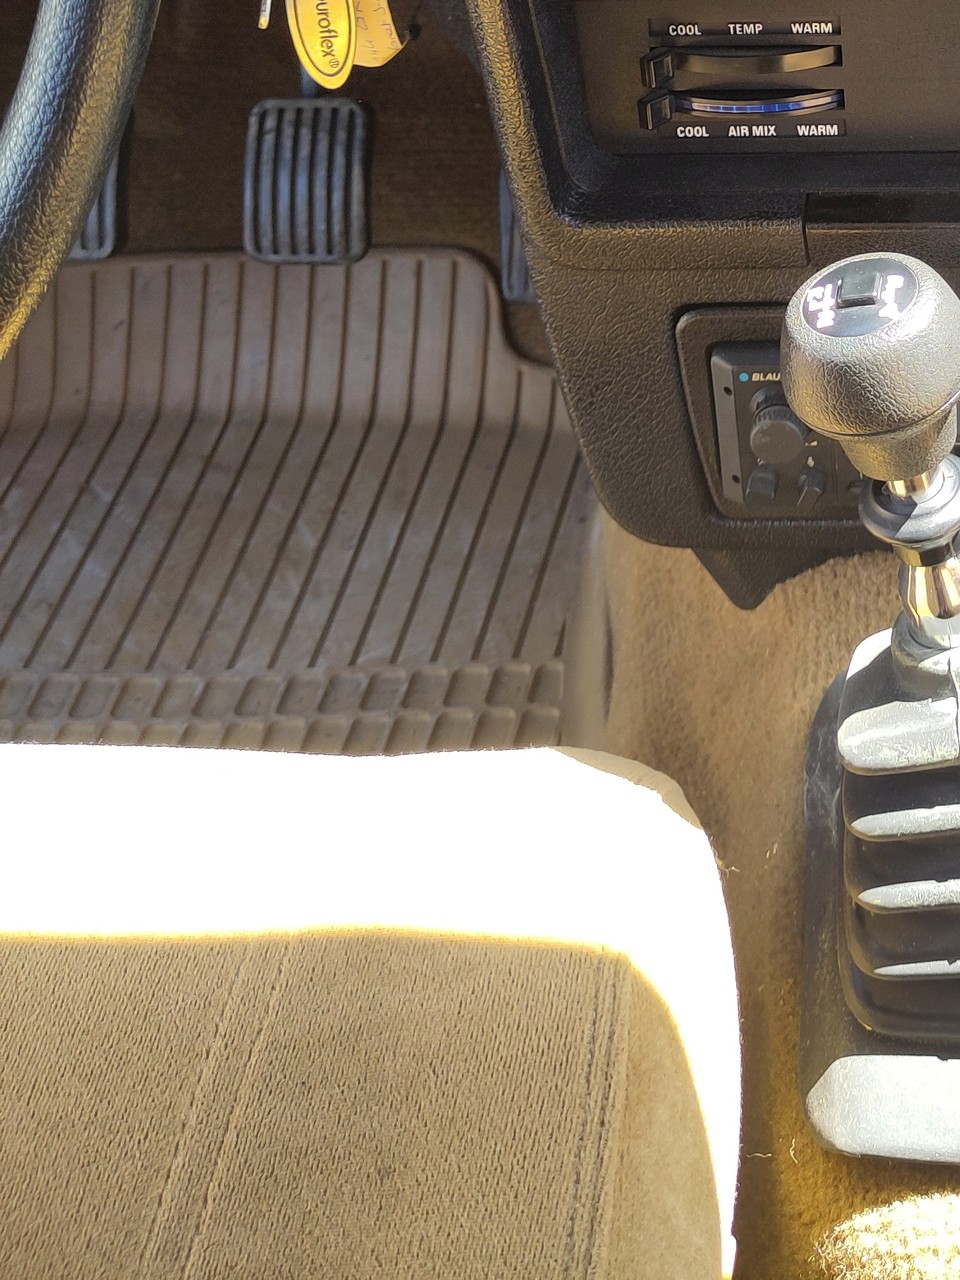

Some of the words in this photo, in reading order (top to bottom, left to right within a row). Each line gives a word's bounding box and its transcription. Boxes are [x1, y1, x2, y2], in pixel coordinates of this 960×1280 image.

[668, 24, 702, 36] COOL
[728, 23, 763, 35] TEMP
[791, 22, 833, 34] WARM
[676, 125, 709, 137] COOL
[728, 125, 749, 137] AIR
[751, 125, 777, 137] MIX
[796, 124, 838, 136] WARM
